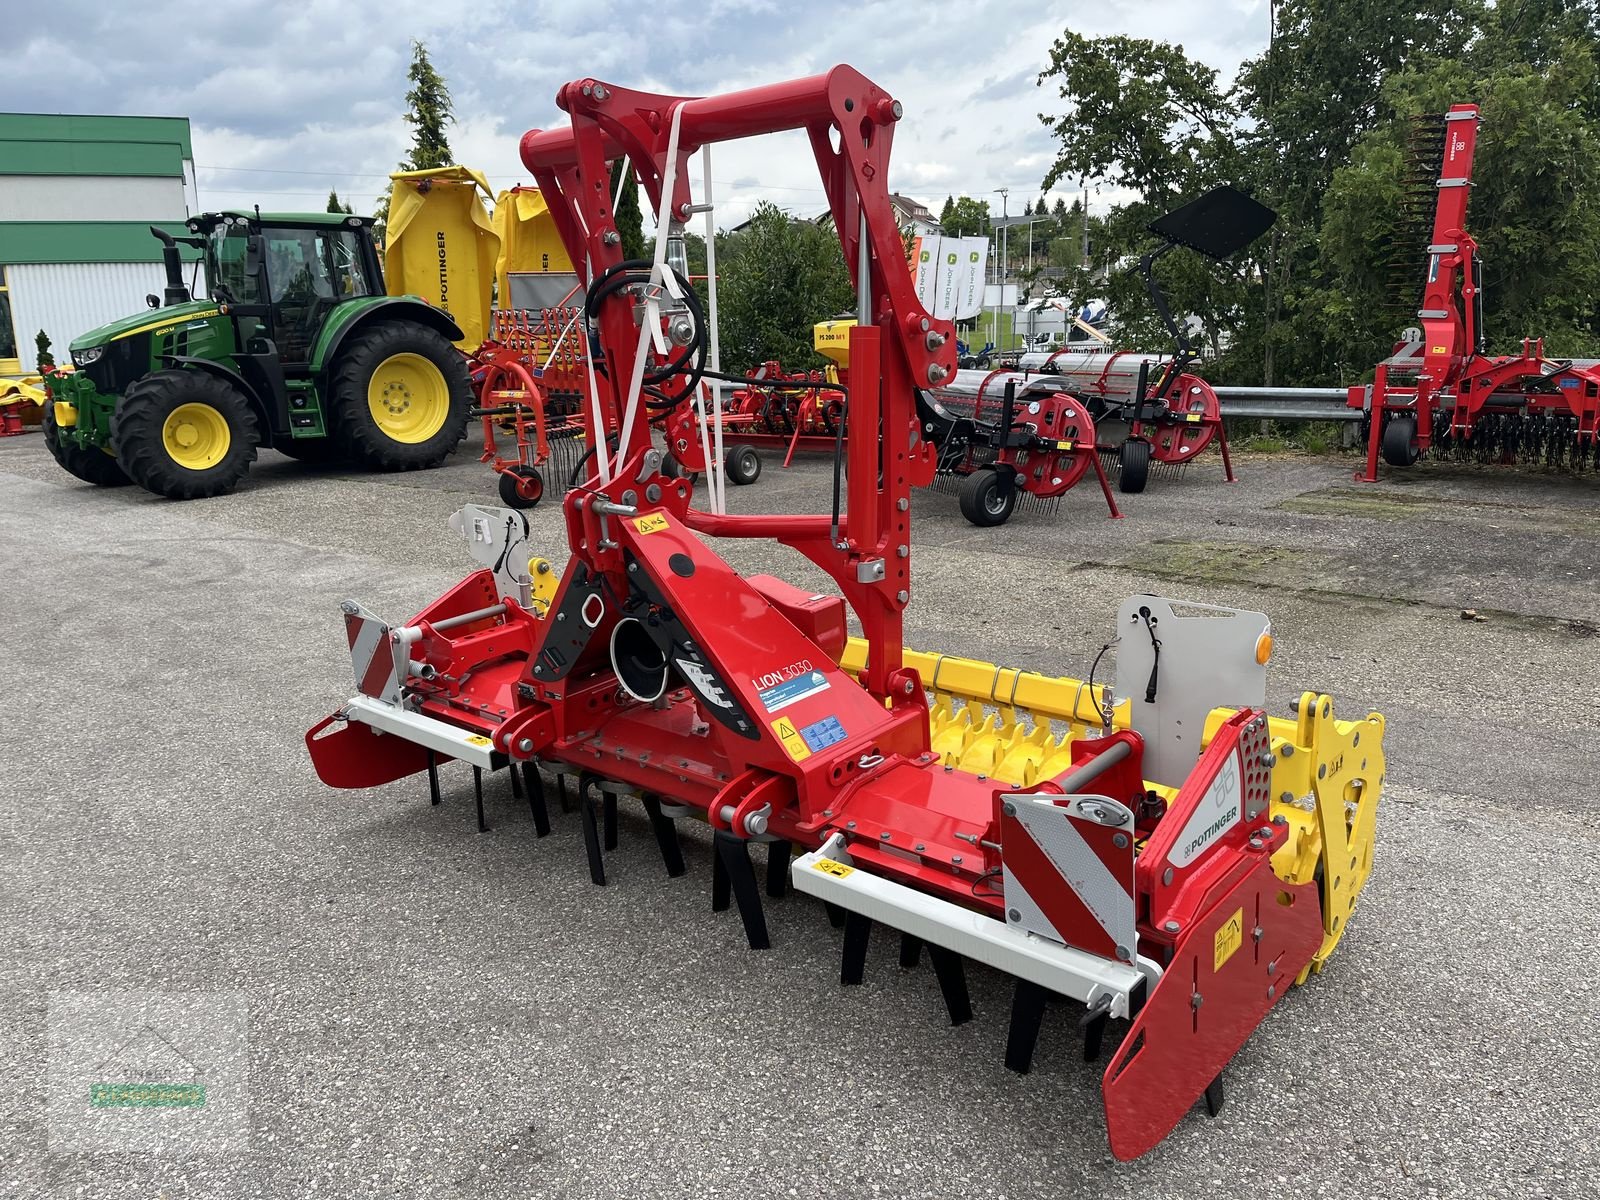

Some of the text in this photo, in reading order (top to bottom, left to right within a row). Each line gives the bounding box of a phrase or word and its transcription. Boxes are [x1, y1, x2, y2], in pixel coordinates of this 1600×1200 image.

[944, 287, 952, 310] DEERE
[752, 659, 813, 691] LION 3030
